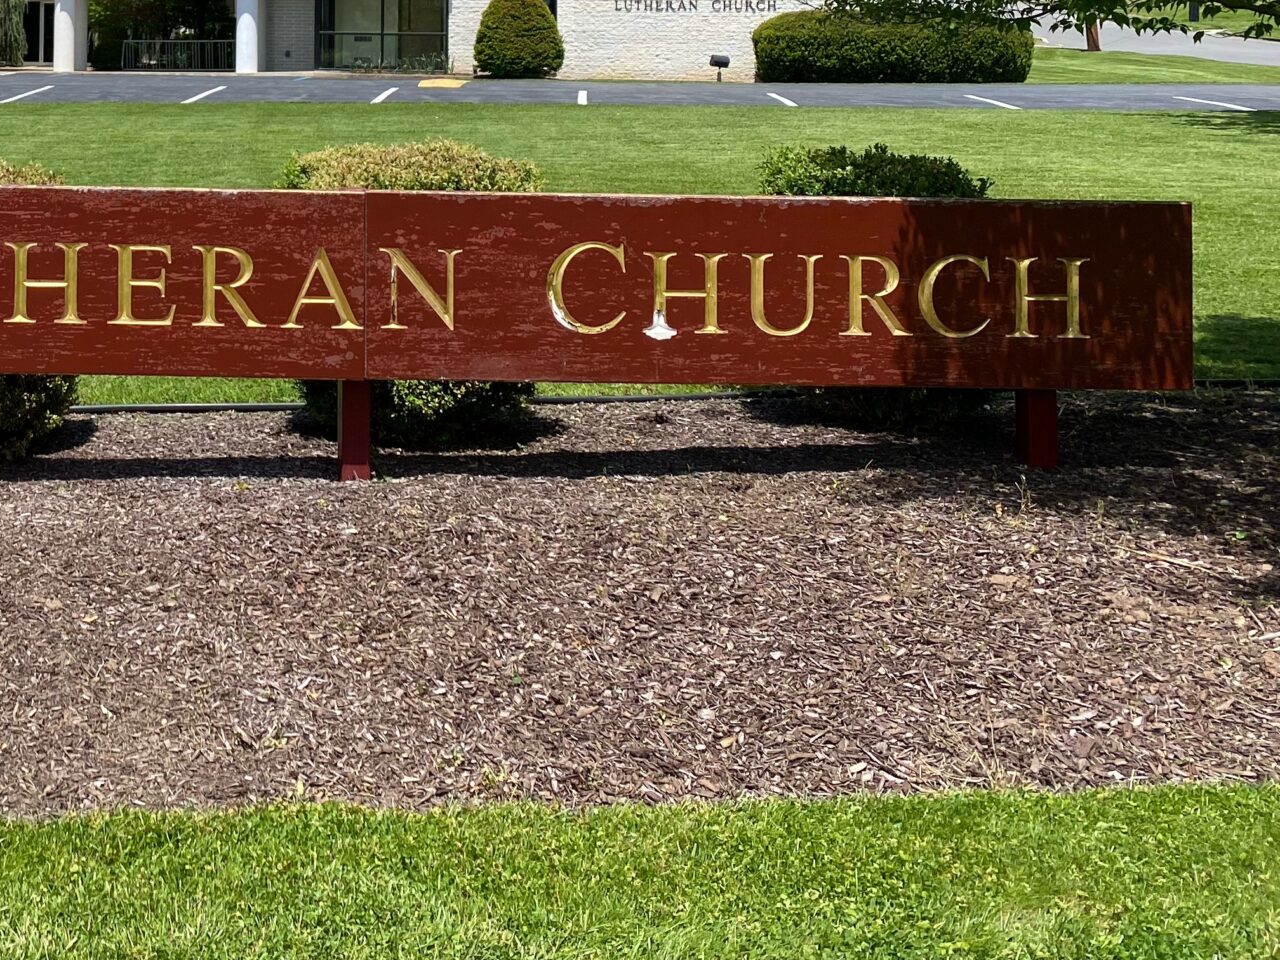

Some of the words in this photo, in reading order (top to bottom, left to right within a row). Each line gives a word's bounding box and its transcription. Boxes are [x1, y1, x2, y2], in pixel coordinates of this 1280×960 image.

[614, 0, 698, 13] LUTHERAN
[711, 0, 777, 14] CHURCH
[545, 241, 1092, 340] CHURCH
